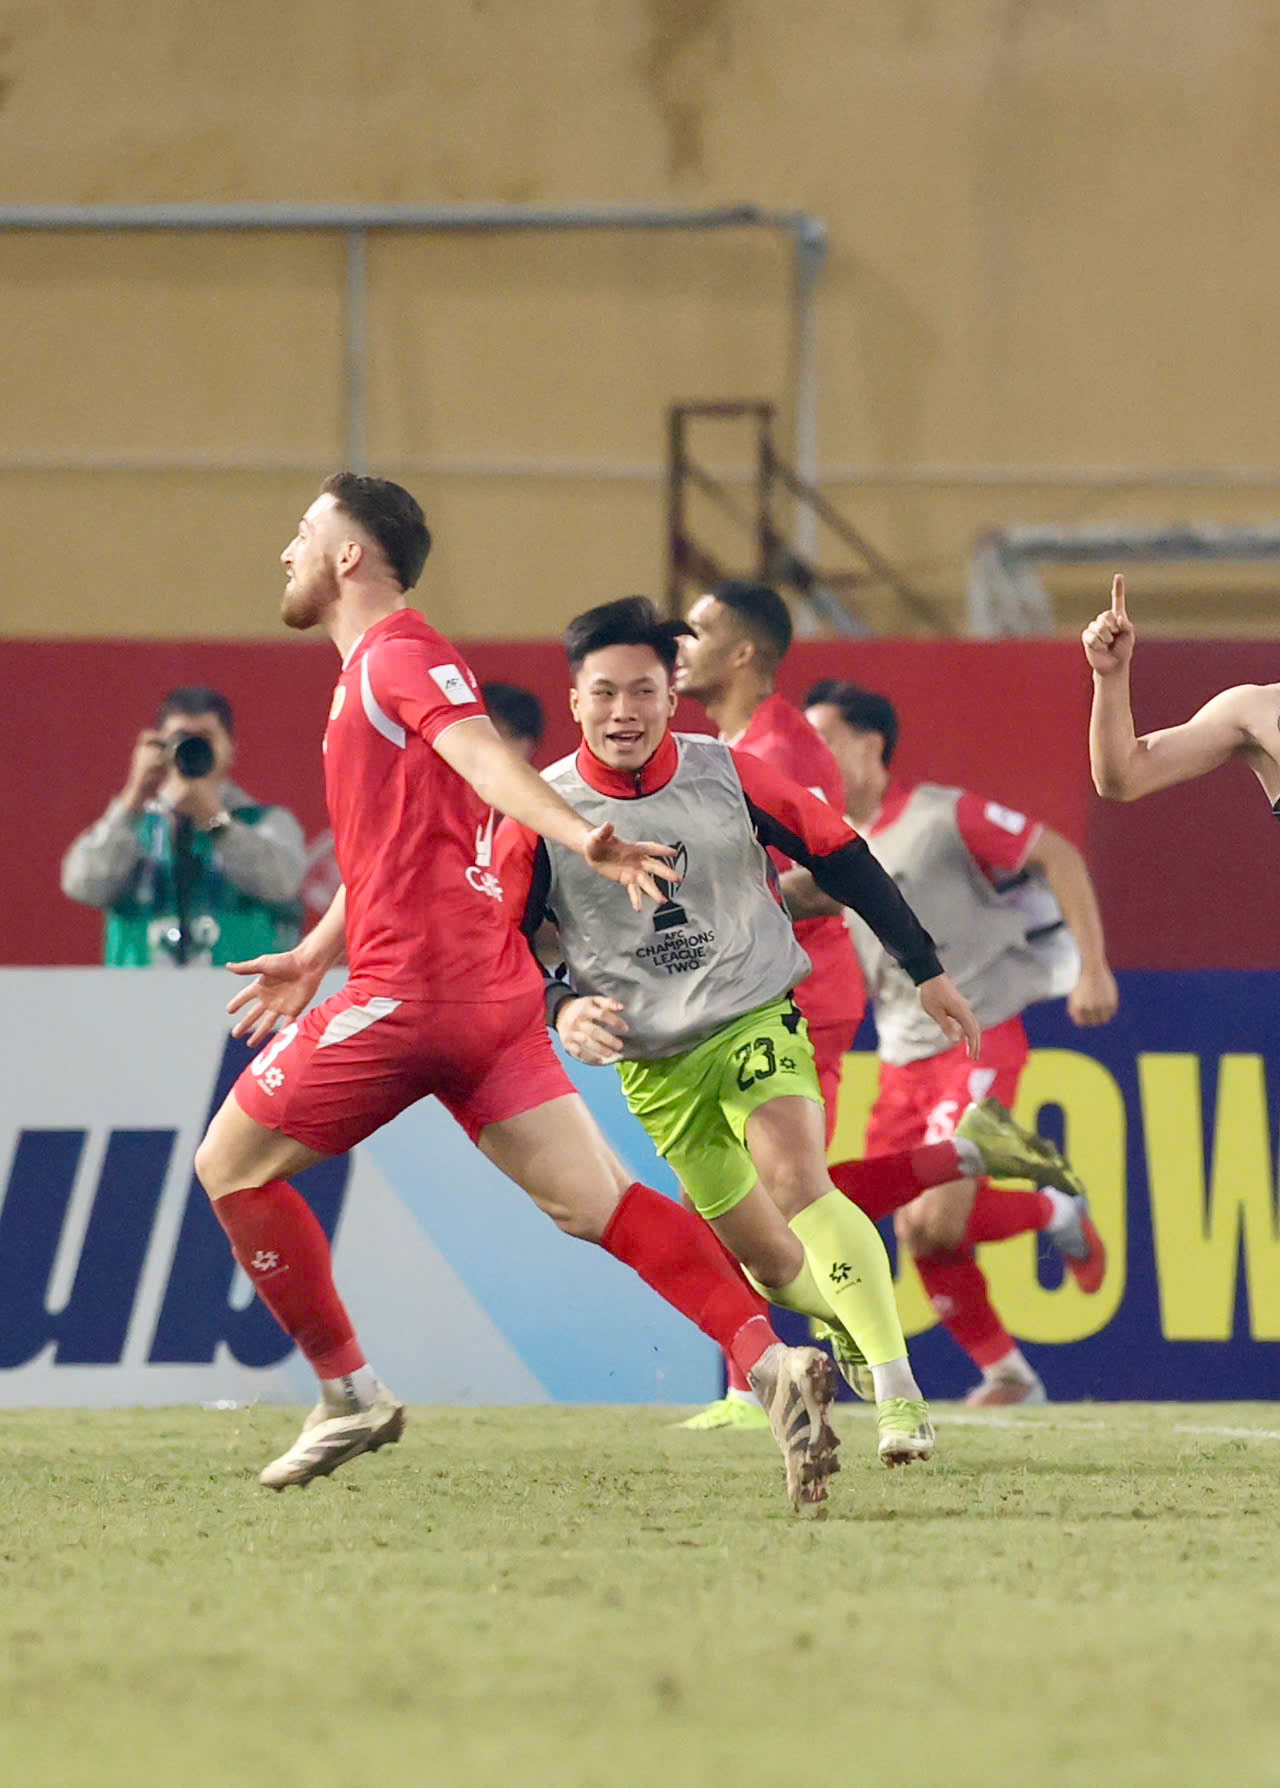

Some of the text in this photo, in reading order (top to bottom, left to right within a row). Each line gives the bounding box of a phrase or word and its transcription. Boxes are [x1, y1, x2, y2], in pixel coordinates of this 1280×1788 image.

[635, 930, 716, 959] CHAMPIONS
[664, 929, 686, 941] AFC
[652, 946, 707, 967] LEAGUE
[665, 960, 701, 975] TWO
[736, 1037, 777, 1092] 23
